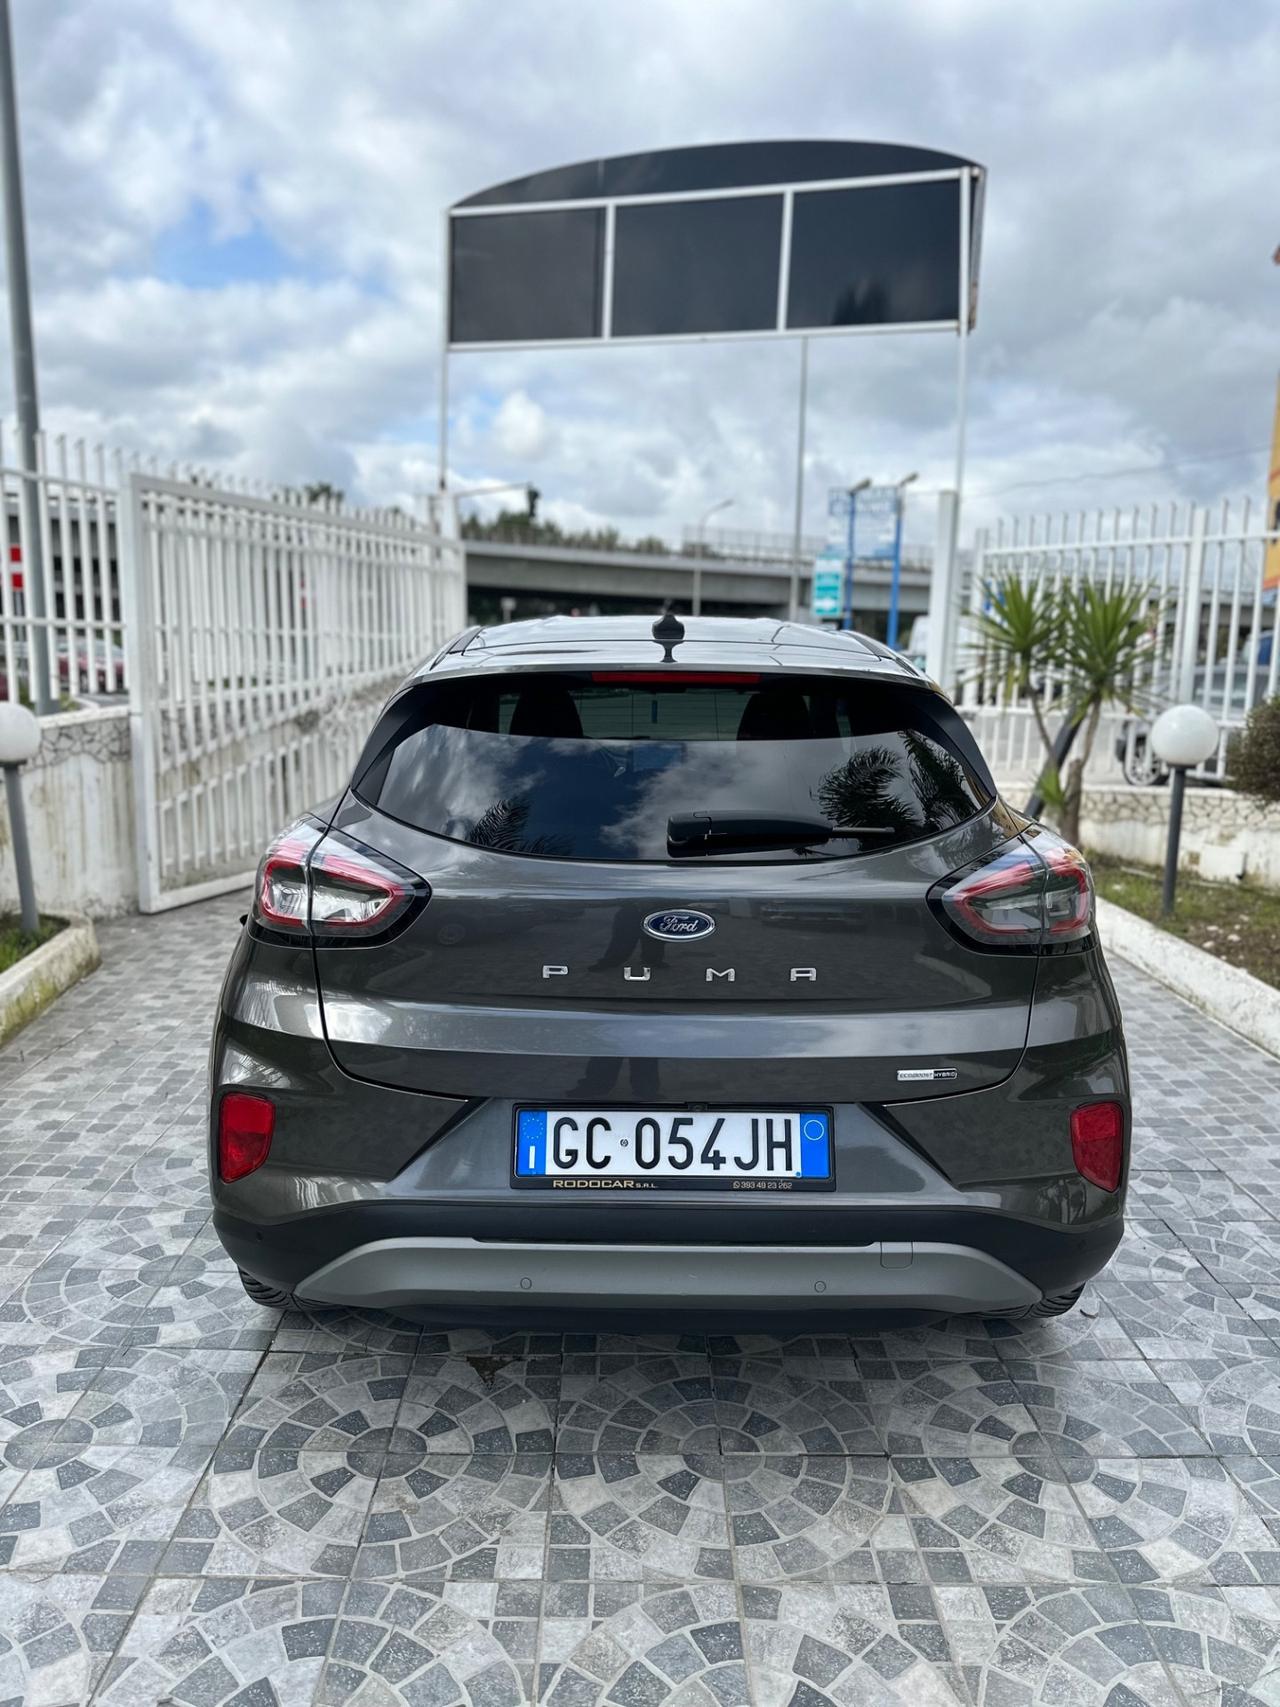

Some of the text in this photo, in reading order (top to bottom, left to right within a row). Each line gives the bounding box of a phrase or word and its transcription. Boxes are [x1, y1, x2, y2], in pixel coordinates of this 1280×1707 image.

[660, 915, 699, 931] Ford
[542, 965, 817, 982] PUMA
[553, 1116, 793, 1172] GC 054JH
[553, 1180, 635, 1189] RODOCAR
